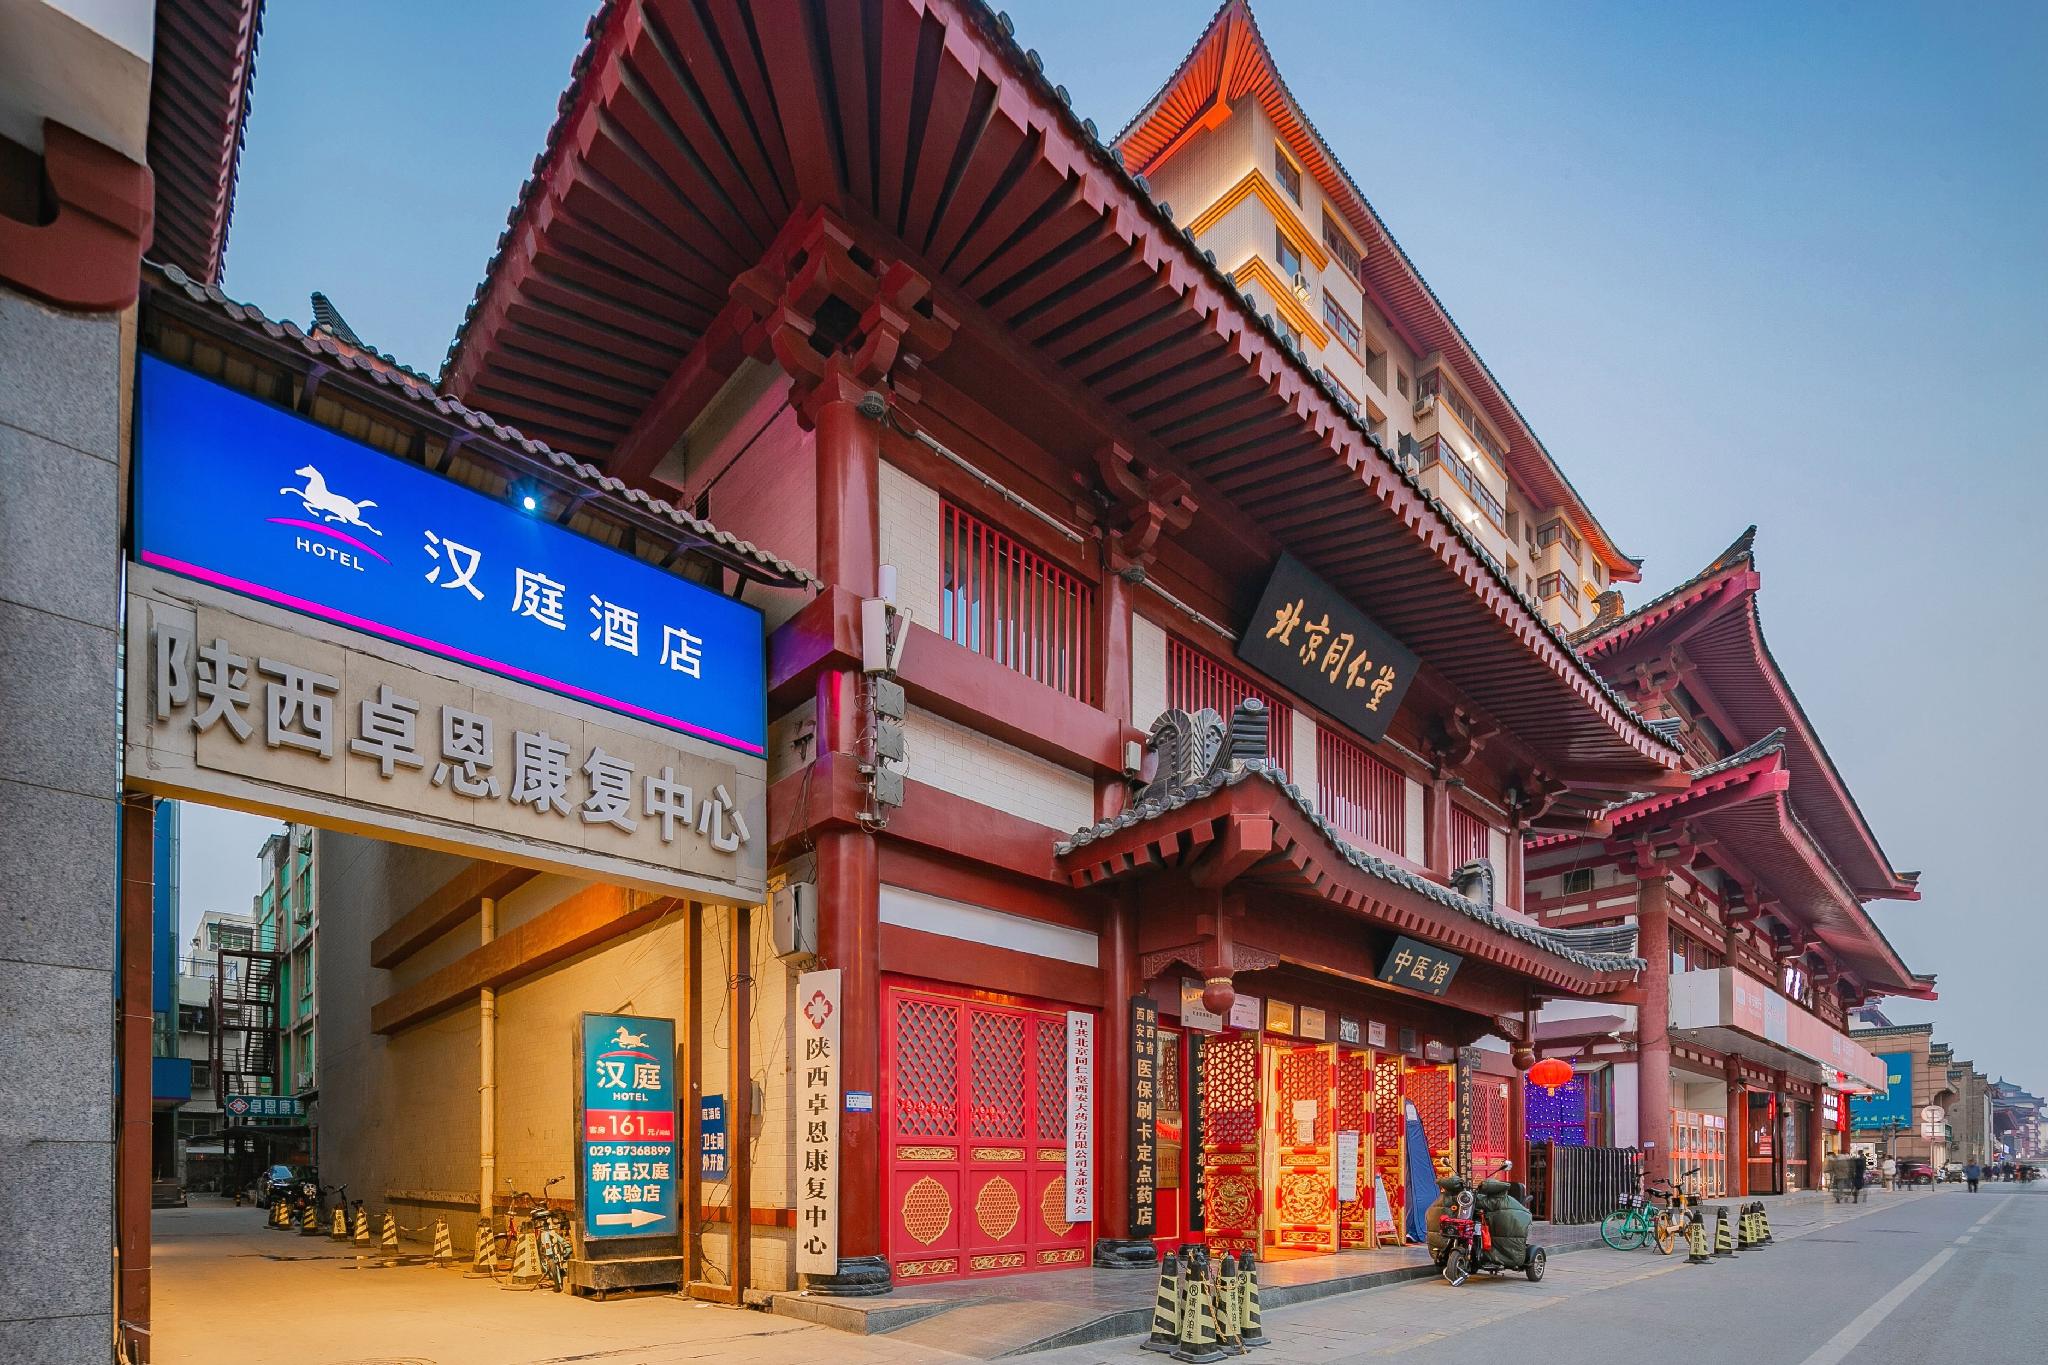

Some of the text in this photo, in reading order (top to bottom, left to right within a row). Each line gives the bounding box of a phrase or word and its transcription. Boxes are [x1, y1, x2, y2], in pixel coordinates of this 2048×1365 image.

[296, 536, 364, 572] HOTEL
[423, 530, 703, 679] 汉庭酒店
[1265, 598, 1396, 712] 北京同仁堂
[156, 622, 750, 854] 陕西卓恩康复中心
[1394, 948, 1450, 985] 中医馆
[1136, 1007, 1145, 1053] 西安市
[1145, 1009, 1155, 1055] 陕西省
[596, 1058, 662, 1090] 汉庭
[613, 1092, 648, 1102] HOTEL
[608, 1115, 645, 1136] 161
[1136, 1058, 1153, 1226] 医保刷卡定点药店
[589, 1146, 671, 1156] 029-87368899
[803, 1036, 831, 1256] 陕西卓恩康复中心
[592, 1162, 670, 1181] 新品汉庭
[602, 1184, 660, 1203] 体验店
[1185, 1298, 1197, 1340] 请勿泊车
